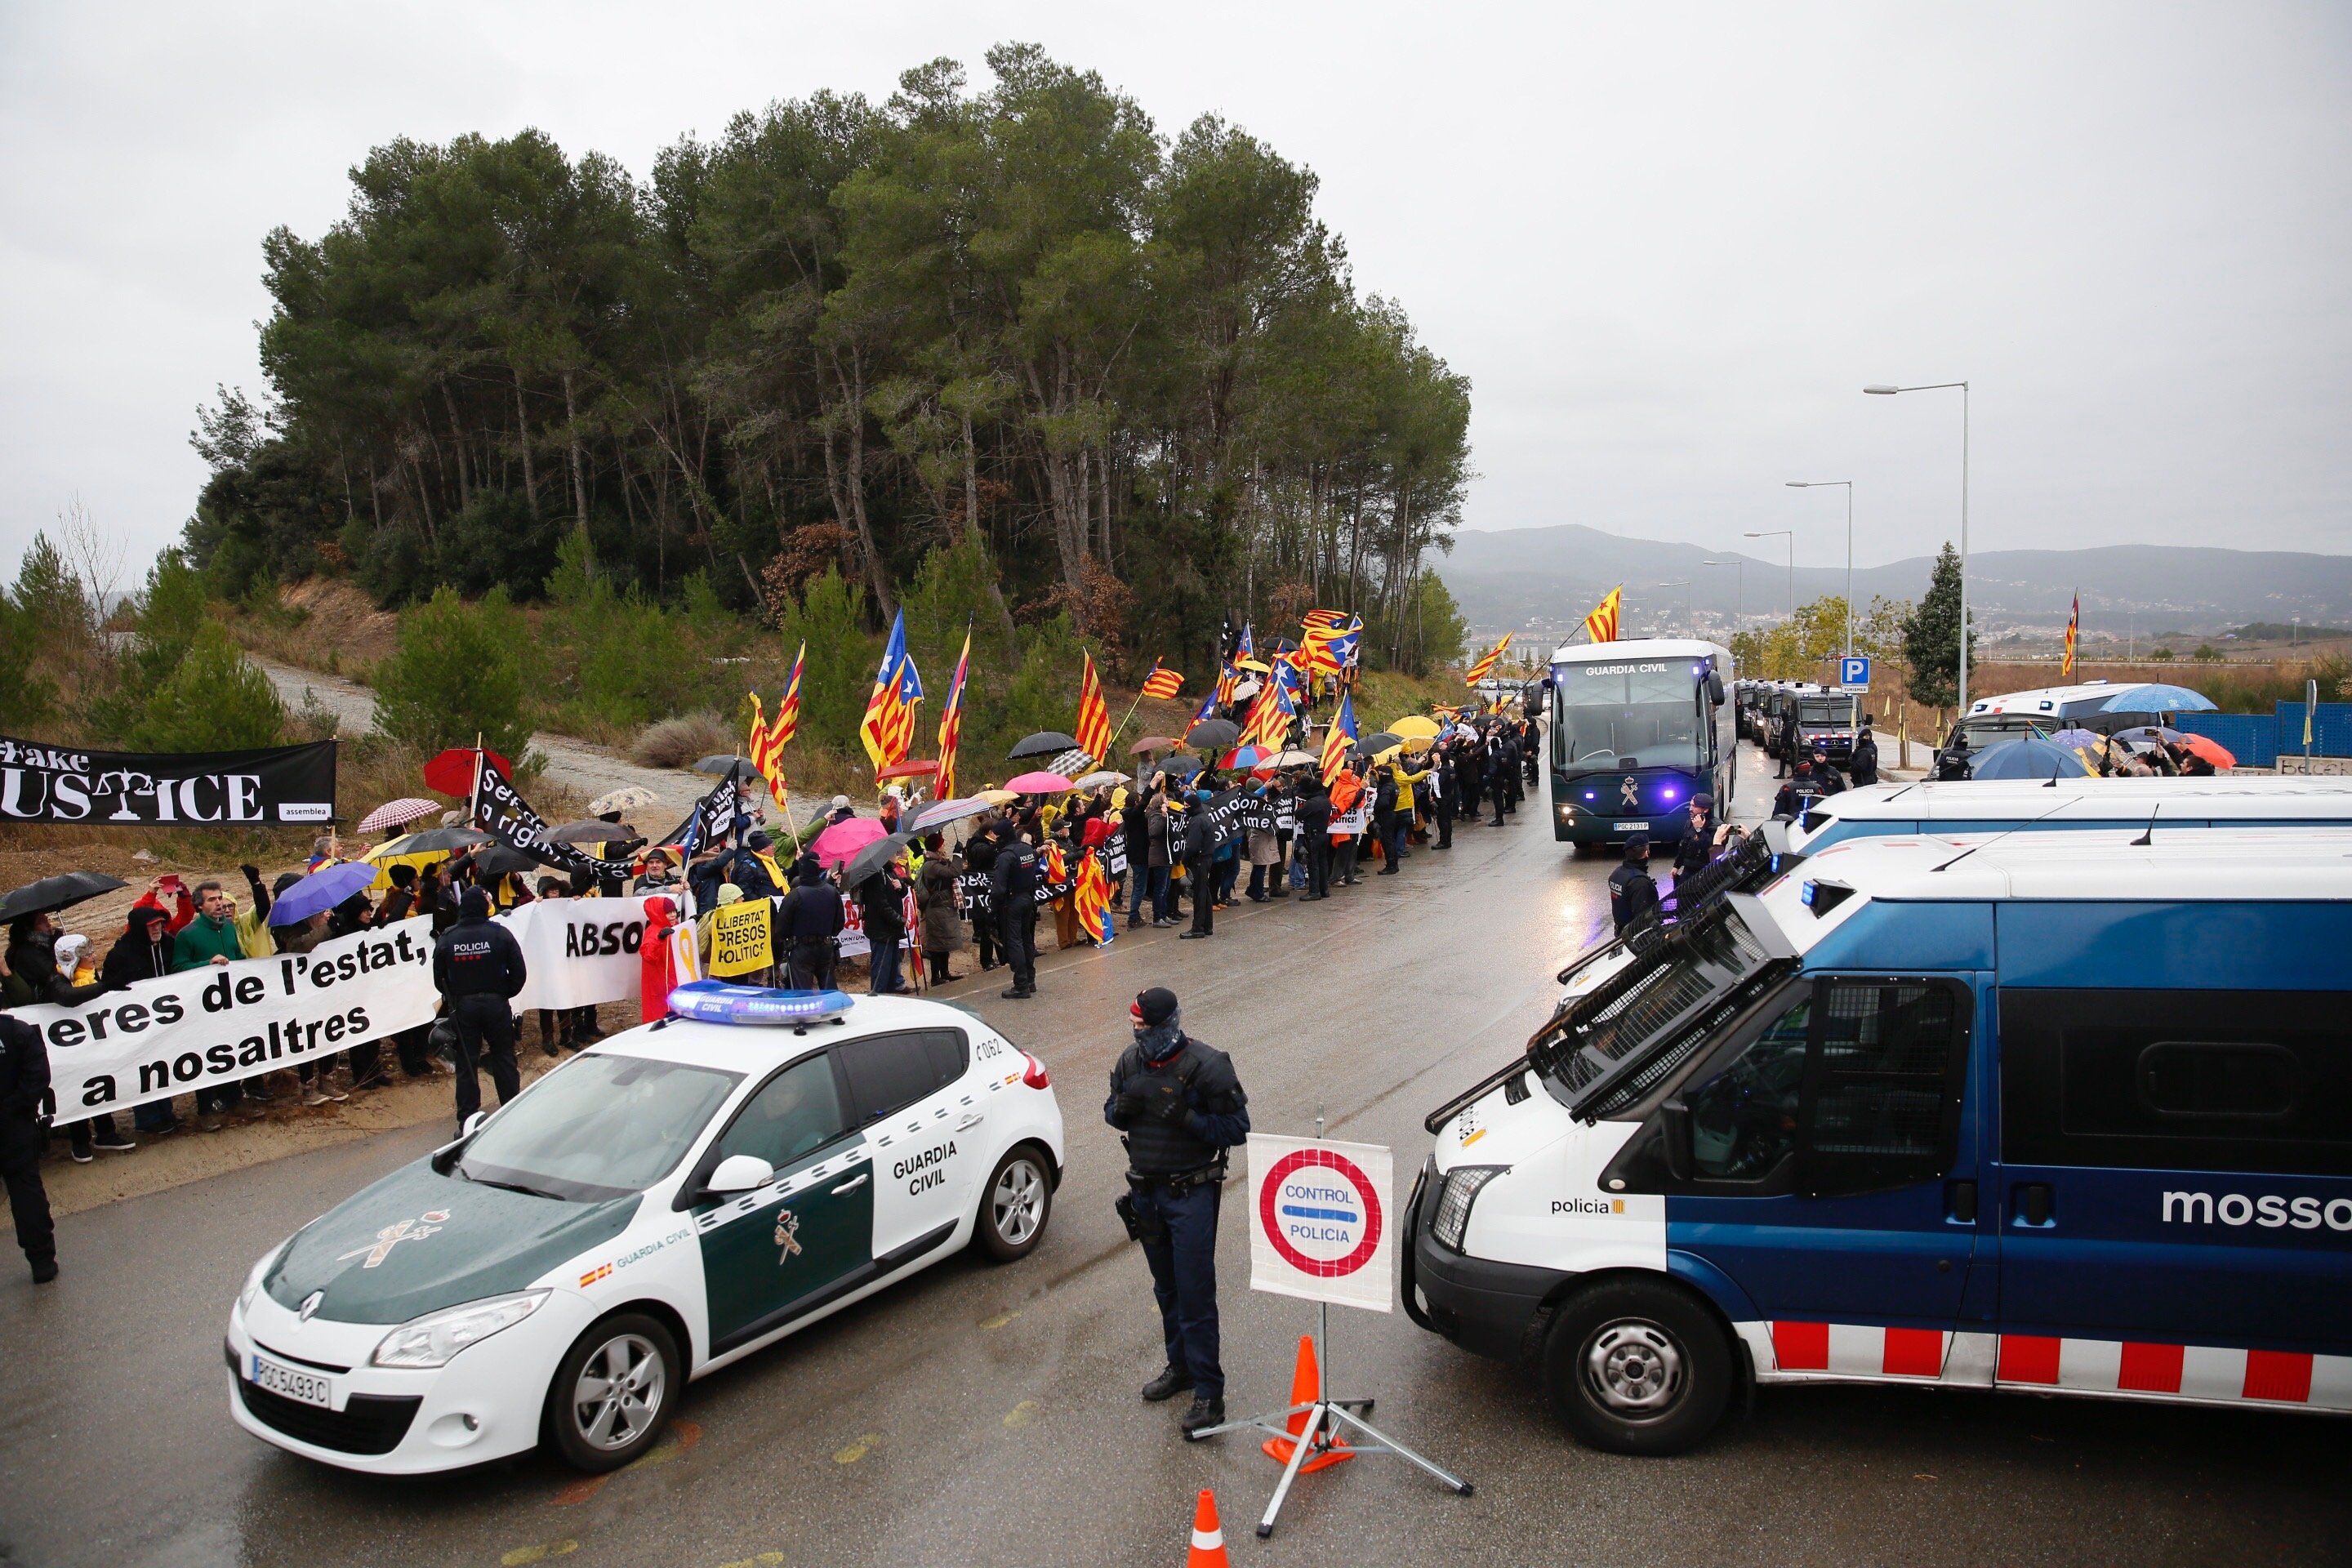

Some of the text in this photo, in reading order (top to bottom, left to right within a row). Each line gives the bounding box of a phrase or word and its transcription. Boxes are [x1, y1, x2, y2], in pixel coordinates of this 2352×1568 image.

[1586, 663, 1667, 676] GUARDIA CIVIL
[1846, 660, 1864, 682] P
[286, 808, 327, 816] assemblea
[718, 924, 766, 947] PRESOS
[453, 941, 491, 952] POLICIA
[202, 972, 265, 1015] de
[699, 994, 734, 1005] GUARDIA
[701, 1004, 723, 1013] CIVIL
[82, 1076, 117, 1107] a
[139, 1006, 371, 1094] nosaltres
[982, 1038, 1002, 1059] 062
[893, 1140, 957, 1179] GUARDIA
[909, 1169, 946, 1196] CIVIL
[1285, 1185, 1354, 1204] CONTROL
[1552, 1198, 1609, 1214] policia
[1290, 1225, 1350, 1243] POLICIA
[617, 1228, 691, 1268] GUARDIA CIVIL
